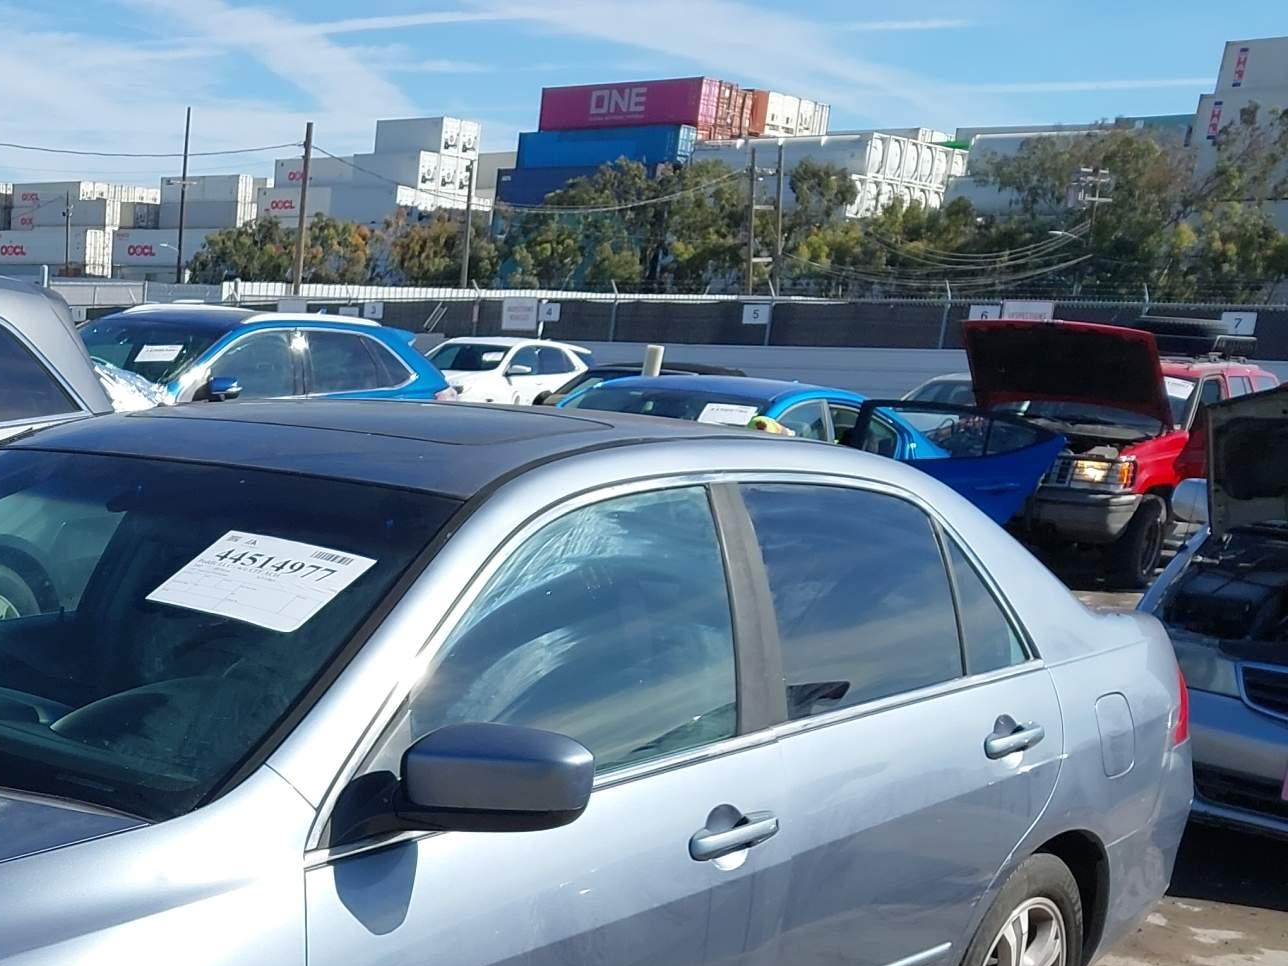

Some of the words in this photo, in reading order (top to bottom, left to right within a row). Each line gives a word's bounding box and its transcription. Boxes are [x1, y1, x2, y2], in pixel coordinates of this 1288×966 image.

[589, 87, 648, 114] ONE
[270, 199, 296, 210] OOCL
[0, 245, 27, 257] OOCL
[127, 244, 156, 257] OOCL
[545, 307, 553, 316] 4
[752, 309, 760, 320] 5
[1233, 317, 1243, 330] 7
[215, 548, 339, 583] 44514977
